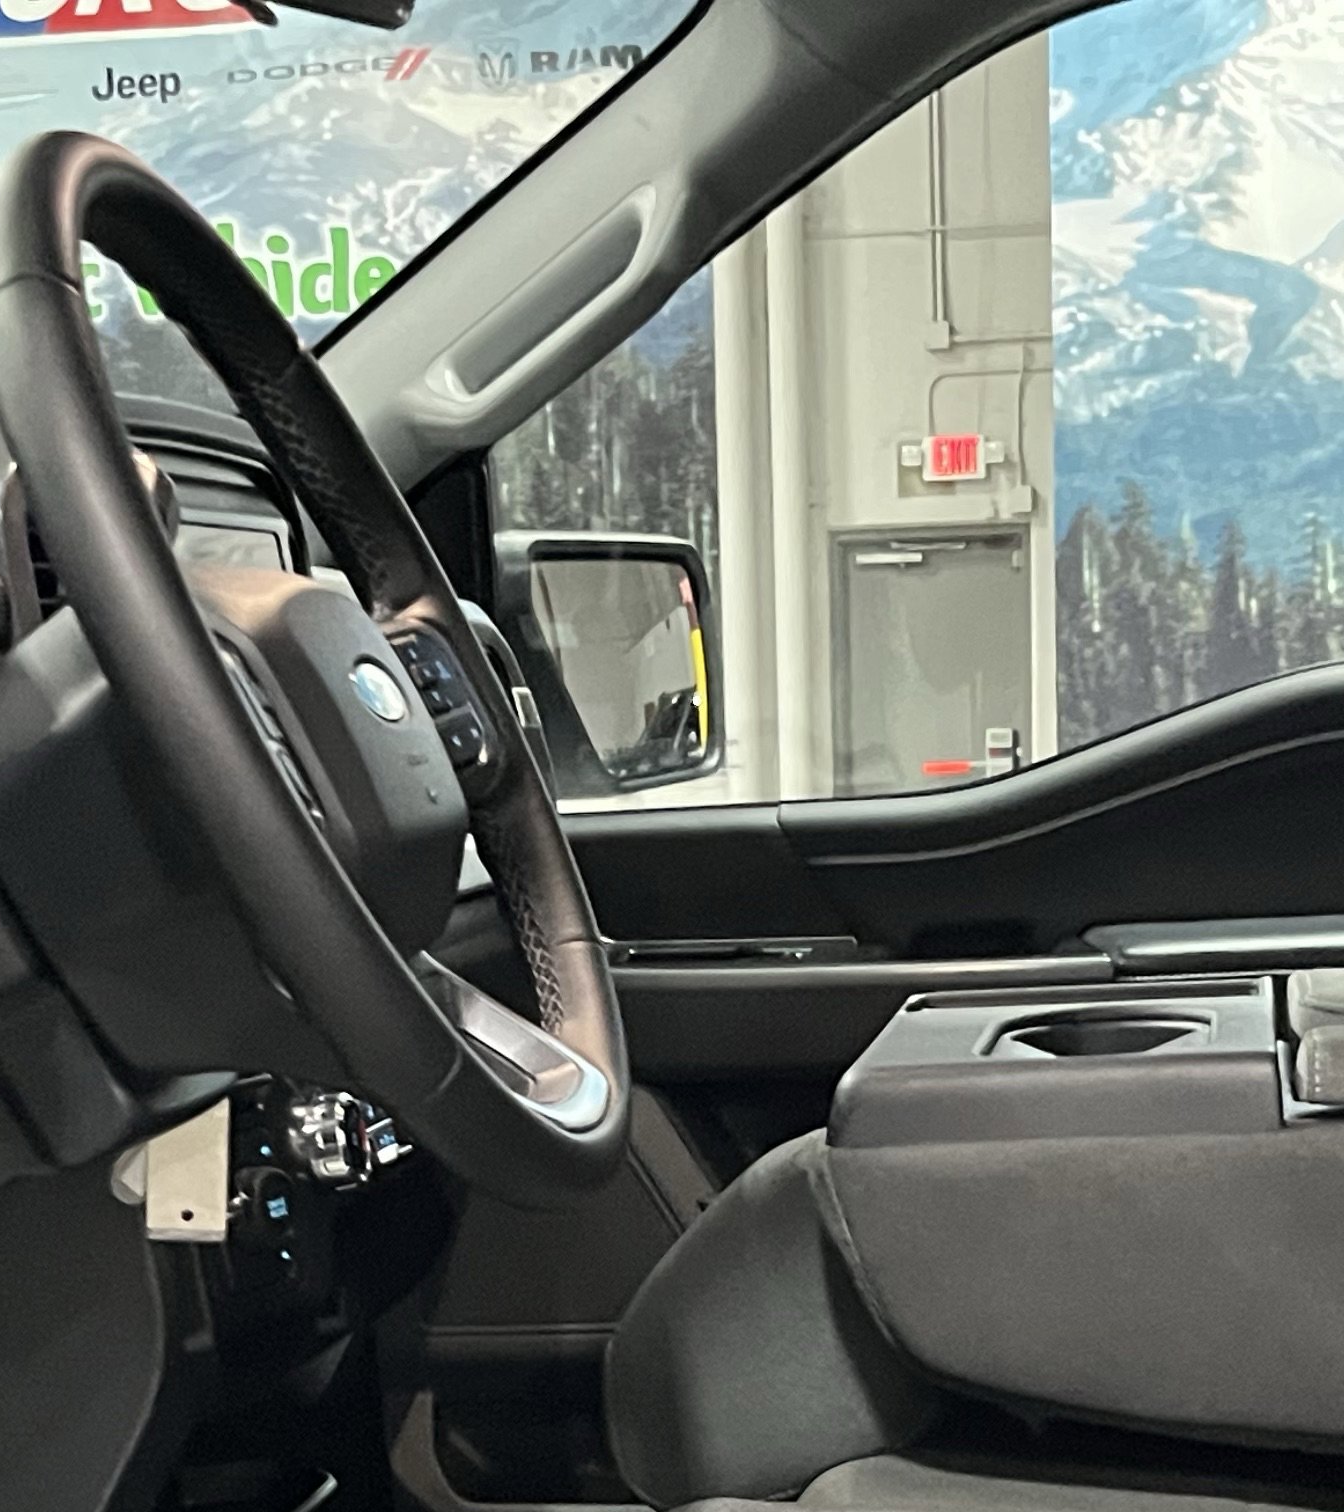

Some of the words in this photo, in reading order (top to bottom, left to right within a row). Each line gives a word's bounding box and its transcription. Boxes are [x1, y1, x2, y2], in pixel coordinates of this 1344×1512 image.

[226, 56, 396, 84] DODGE
[530, 44, 644, 73] RAM
[91, 66, 181, 104] Jeep
[932, 436, 978, 475] EXIT
